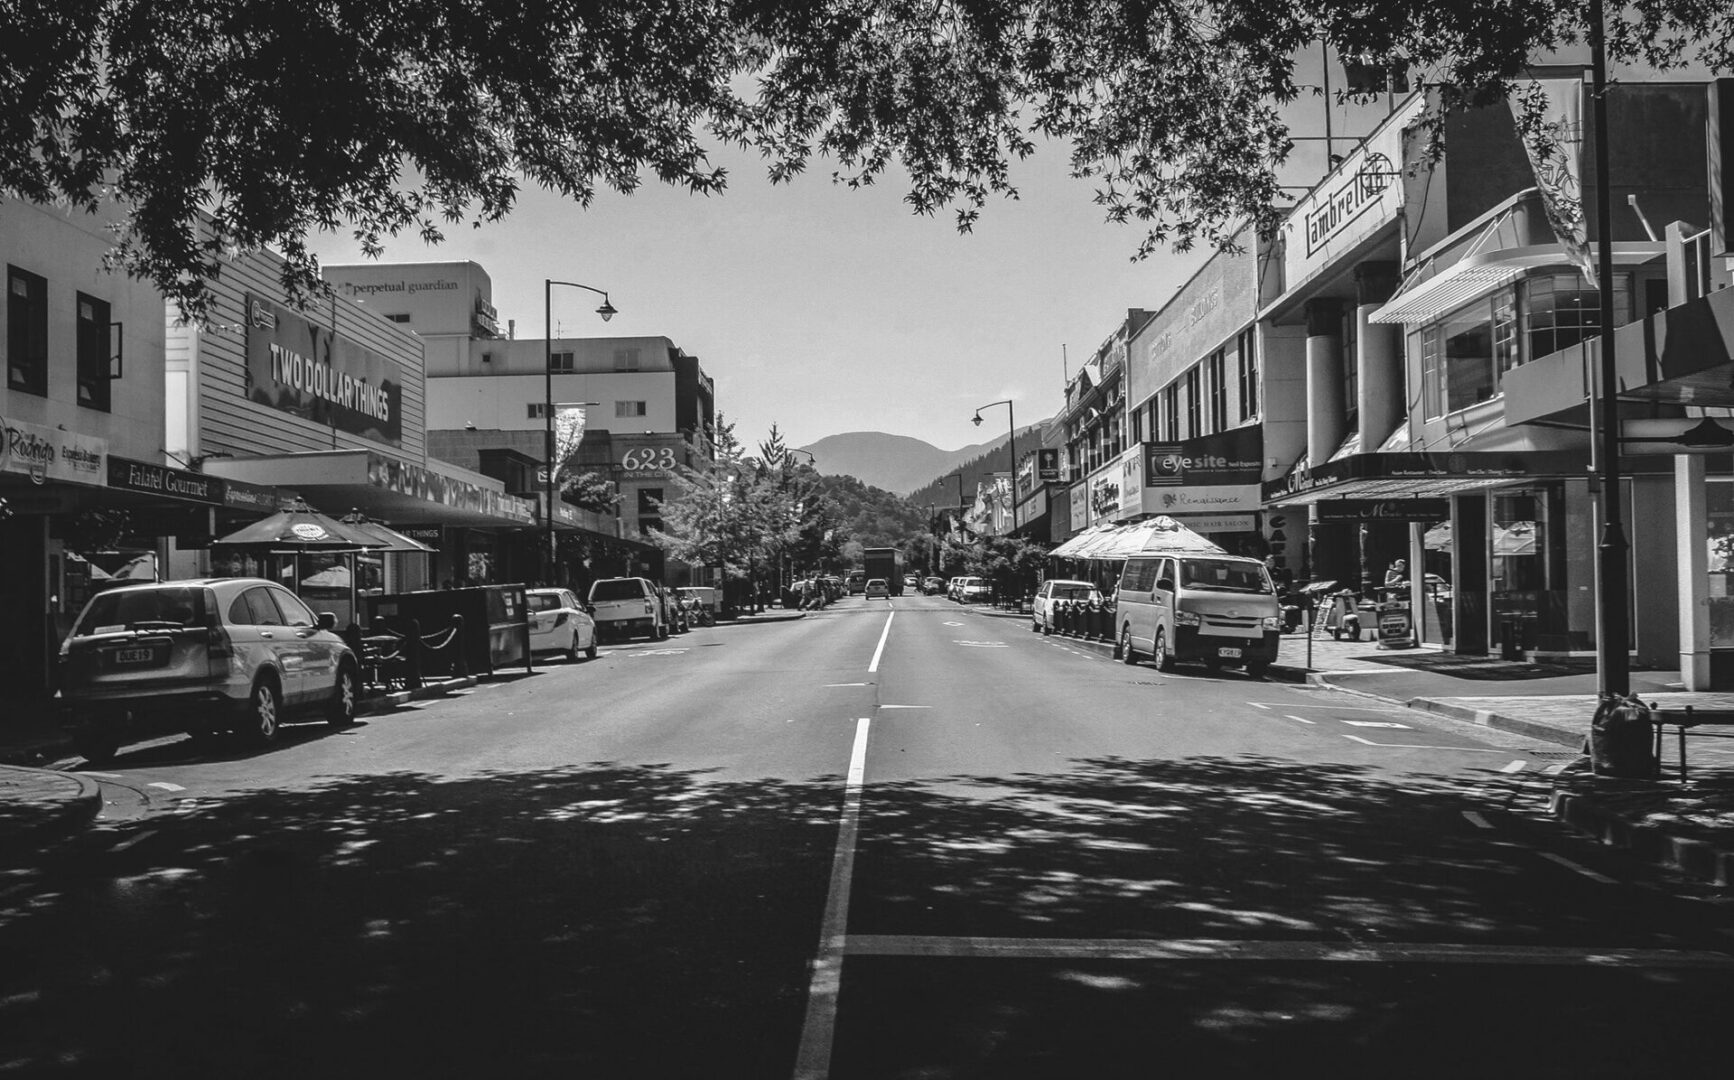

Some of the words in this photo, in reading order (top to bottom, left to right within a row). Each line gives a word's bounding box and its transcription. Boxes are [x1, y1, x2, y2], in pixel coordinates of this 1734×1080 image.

[353, 280, 405, 296] perpetual
[408, 279, 459, 294] guardian
[269, 342, 302, 390] TWO
[304, 358, 352, 409] DOLLAR
[353, 377, 389, 422] THINGS
[622, 447, 677, 471] 623
[1162, 455, 1192, 473] eye
[1194, 454, 1227, 469] site
[128, 464, 164, 490] Falafel
[165, 470, 209, 498] Gourmet
